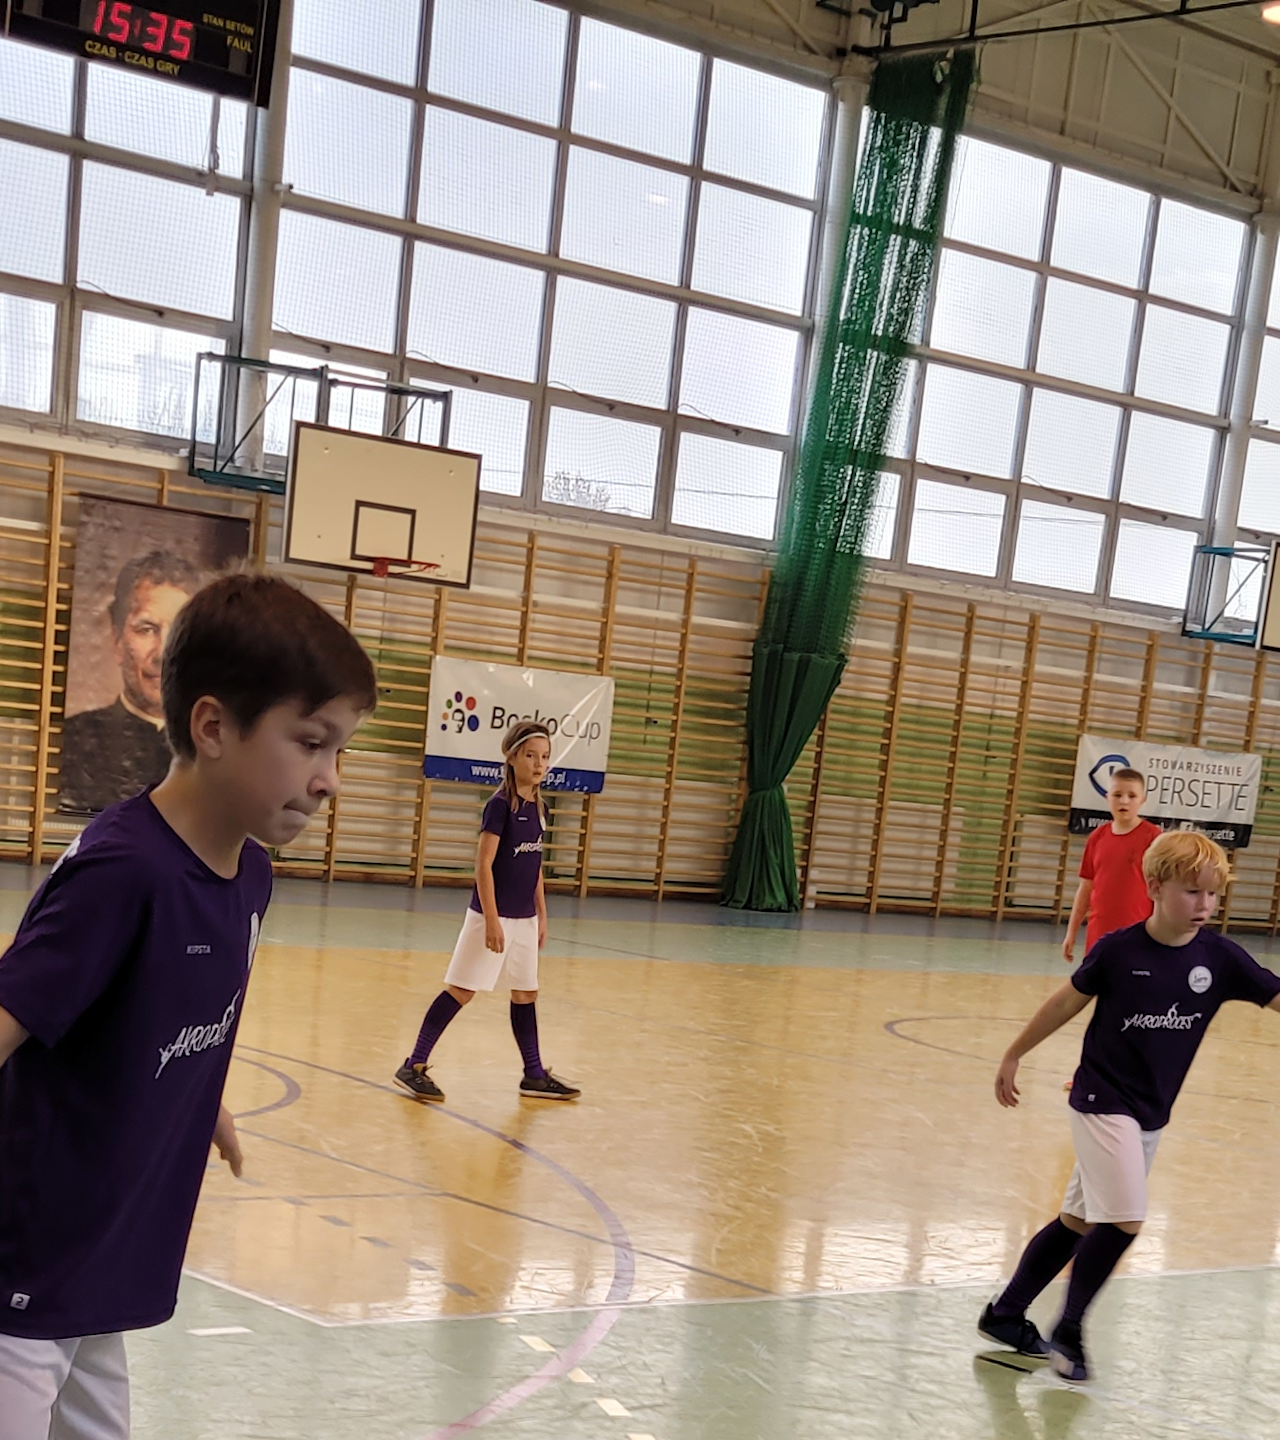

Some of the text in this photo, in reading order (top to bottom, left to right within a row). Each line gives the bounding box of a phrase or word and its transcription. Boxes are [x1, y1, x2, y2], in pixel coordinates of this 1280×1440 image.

[92, 0, 194, 61] 15:35
[202, 13, 255, 36] STAN SETÓW
[84, 39, 117, 59] CZAS
[124, 50, 155, 70] CZAS
[156, 60, 181, 77] GRY
[226, 34, 253, 53] FAUL
[1148, 757, 1243, 777] STOWARZYSZENIE
[1146, 774, 1250, 812] PERSETTE
